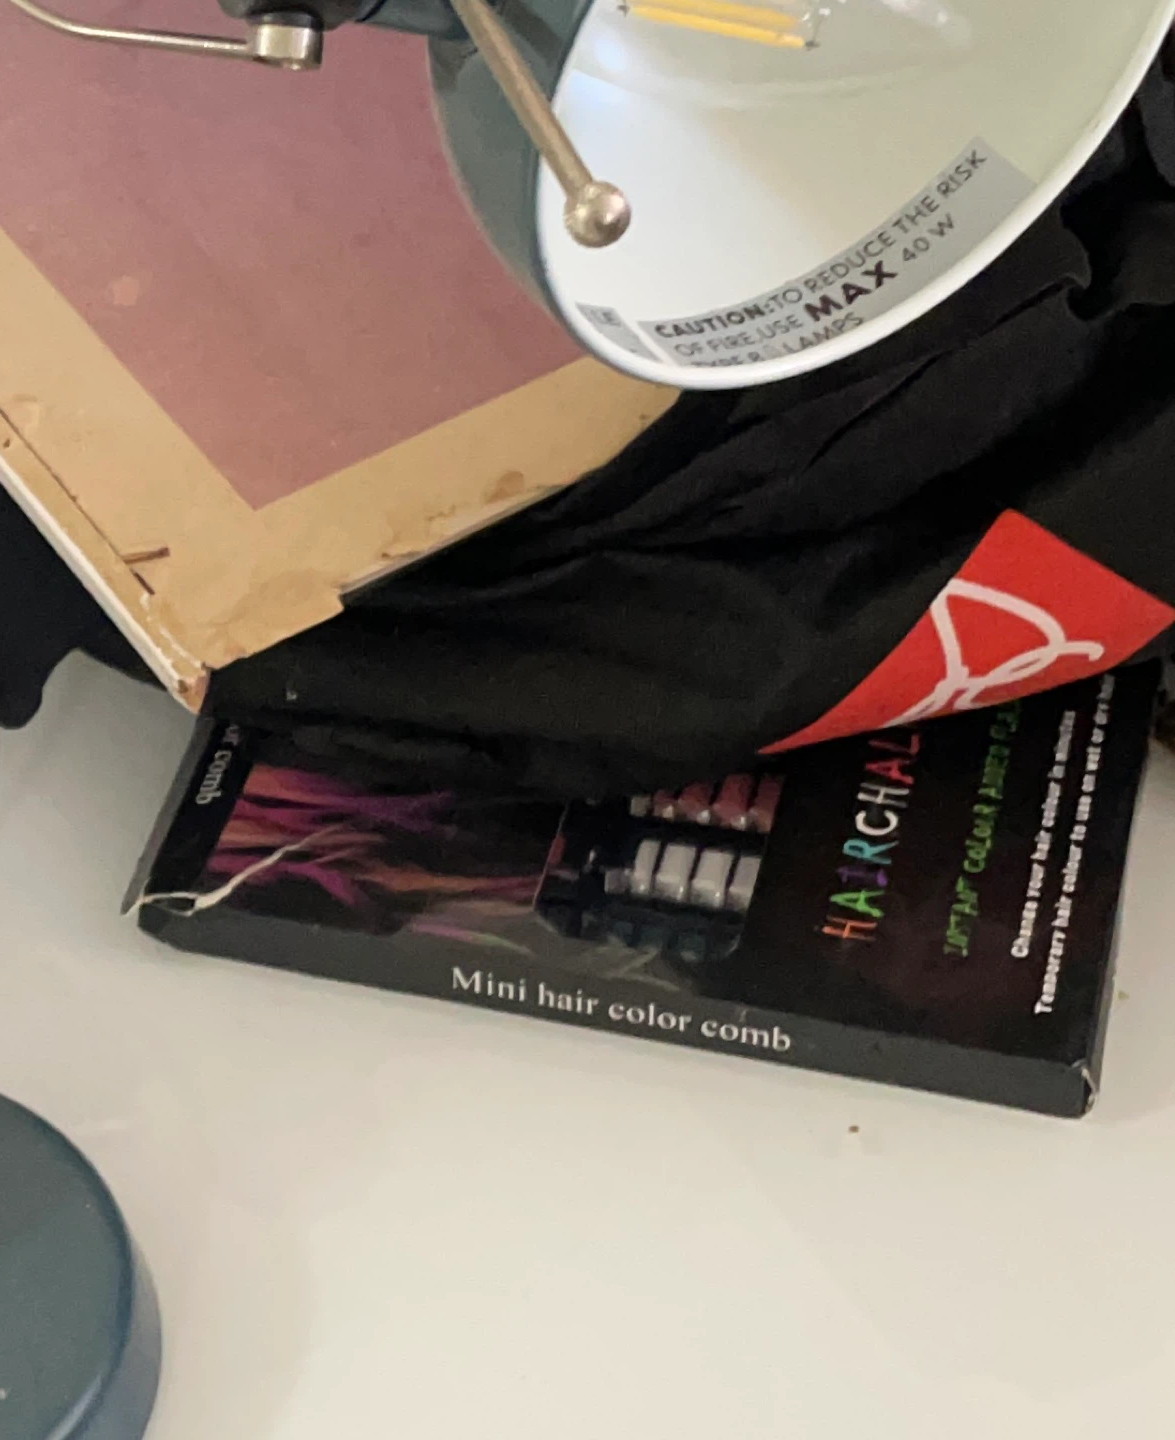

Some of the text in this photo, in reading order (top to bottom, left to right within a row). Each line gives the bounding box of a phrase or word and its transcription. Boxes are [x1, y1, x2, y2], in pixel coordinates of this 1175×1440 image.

[804, 231, 896, 293] REDUCE
[892, 196, 939, 234] THE
[937, 150, 987, 198] RISK
[804, 260, 898, 322] MAX
[196, 750, 232, 804] comb
[1042, 781, 1062, 828] colour
[821, 733, 922, 941] HAIRCHAL
[1030, 829, 1052, 861] hair
[1069, 824, 1087, 841] to
[1026, 862, 1045, 897] your
[1061, 845, 1083, 893] colour
[1010, 900, 1039, 958] Change
[1051, 896, 1073, 927] hair
[1034, 930, 1067, 1014] Temporary
[451, 966, 792, 1052] Mini hair color comb
